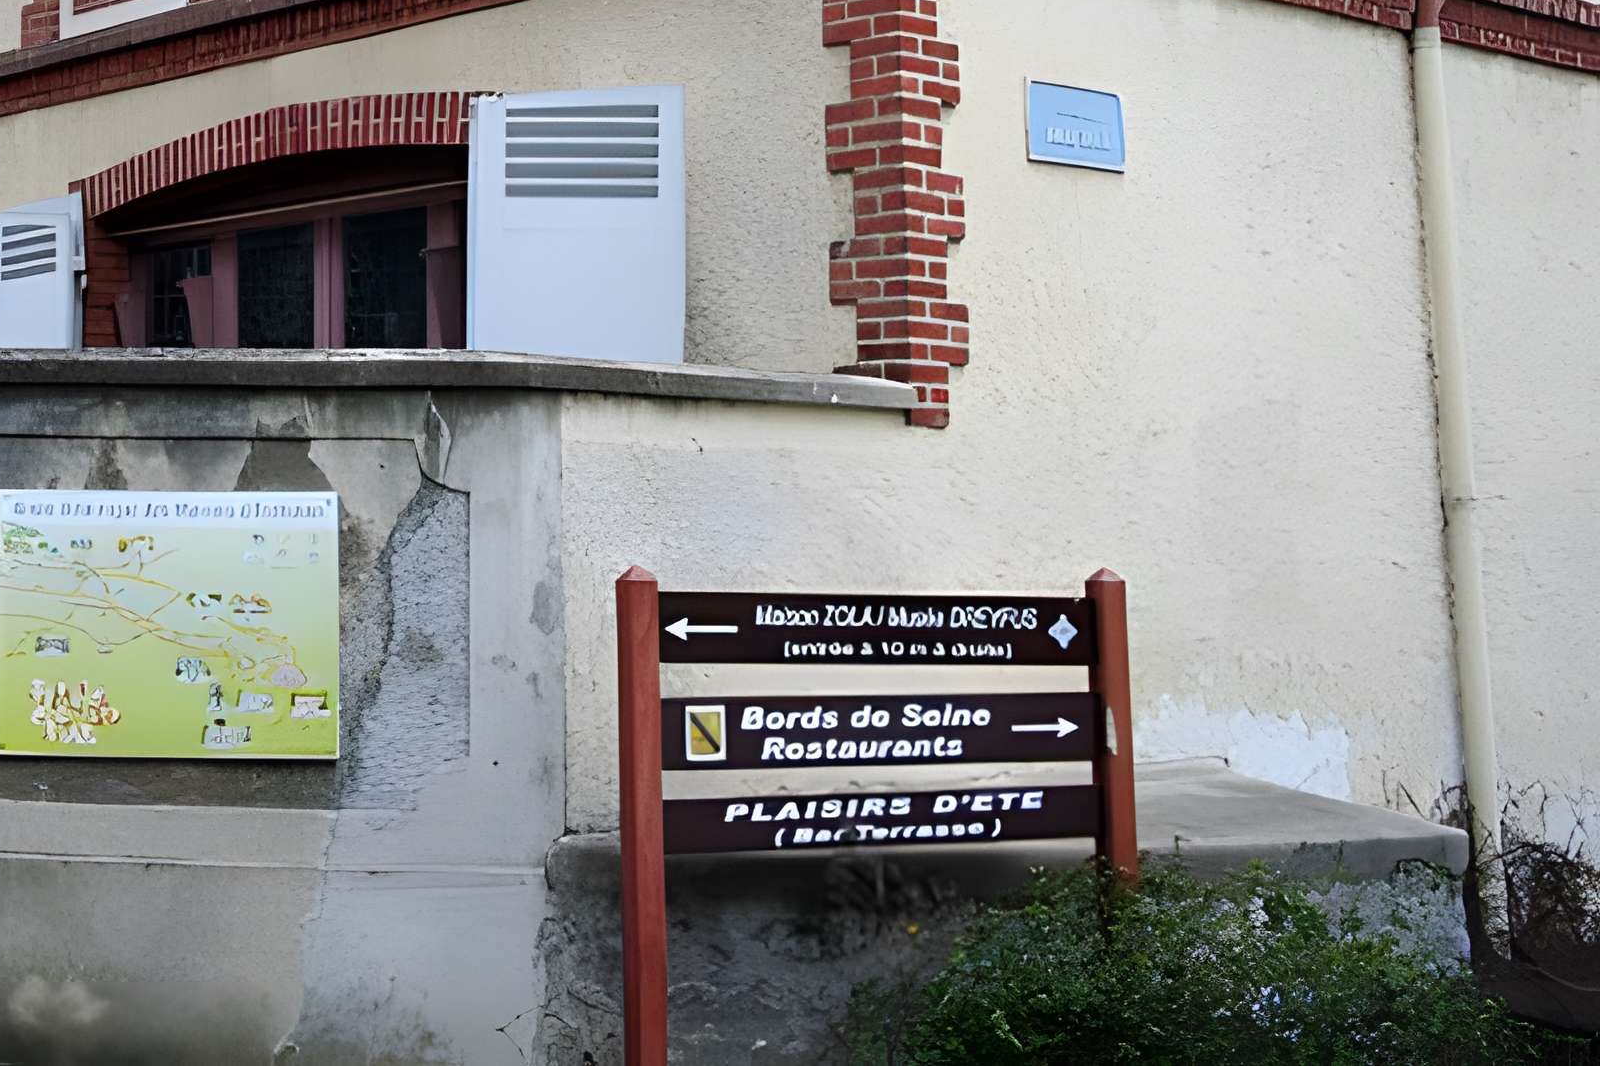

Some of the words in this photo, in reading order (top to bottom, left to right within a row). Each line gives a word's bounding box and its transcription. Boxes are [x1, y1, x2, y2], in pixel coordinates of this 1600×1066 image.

[881, 641, 904, 656] 10
[740, 705, 839, 731] Bords
[724, 797, 912, 822] PLAISIRS
